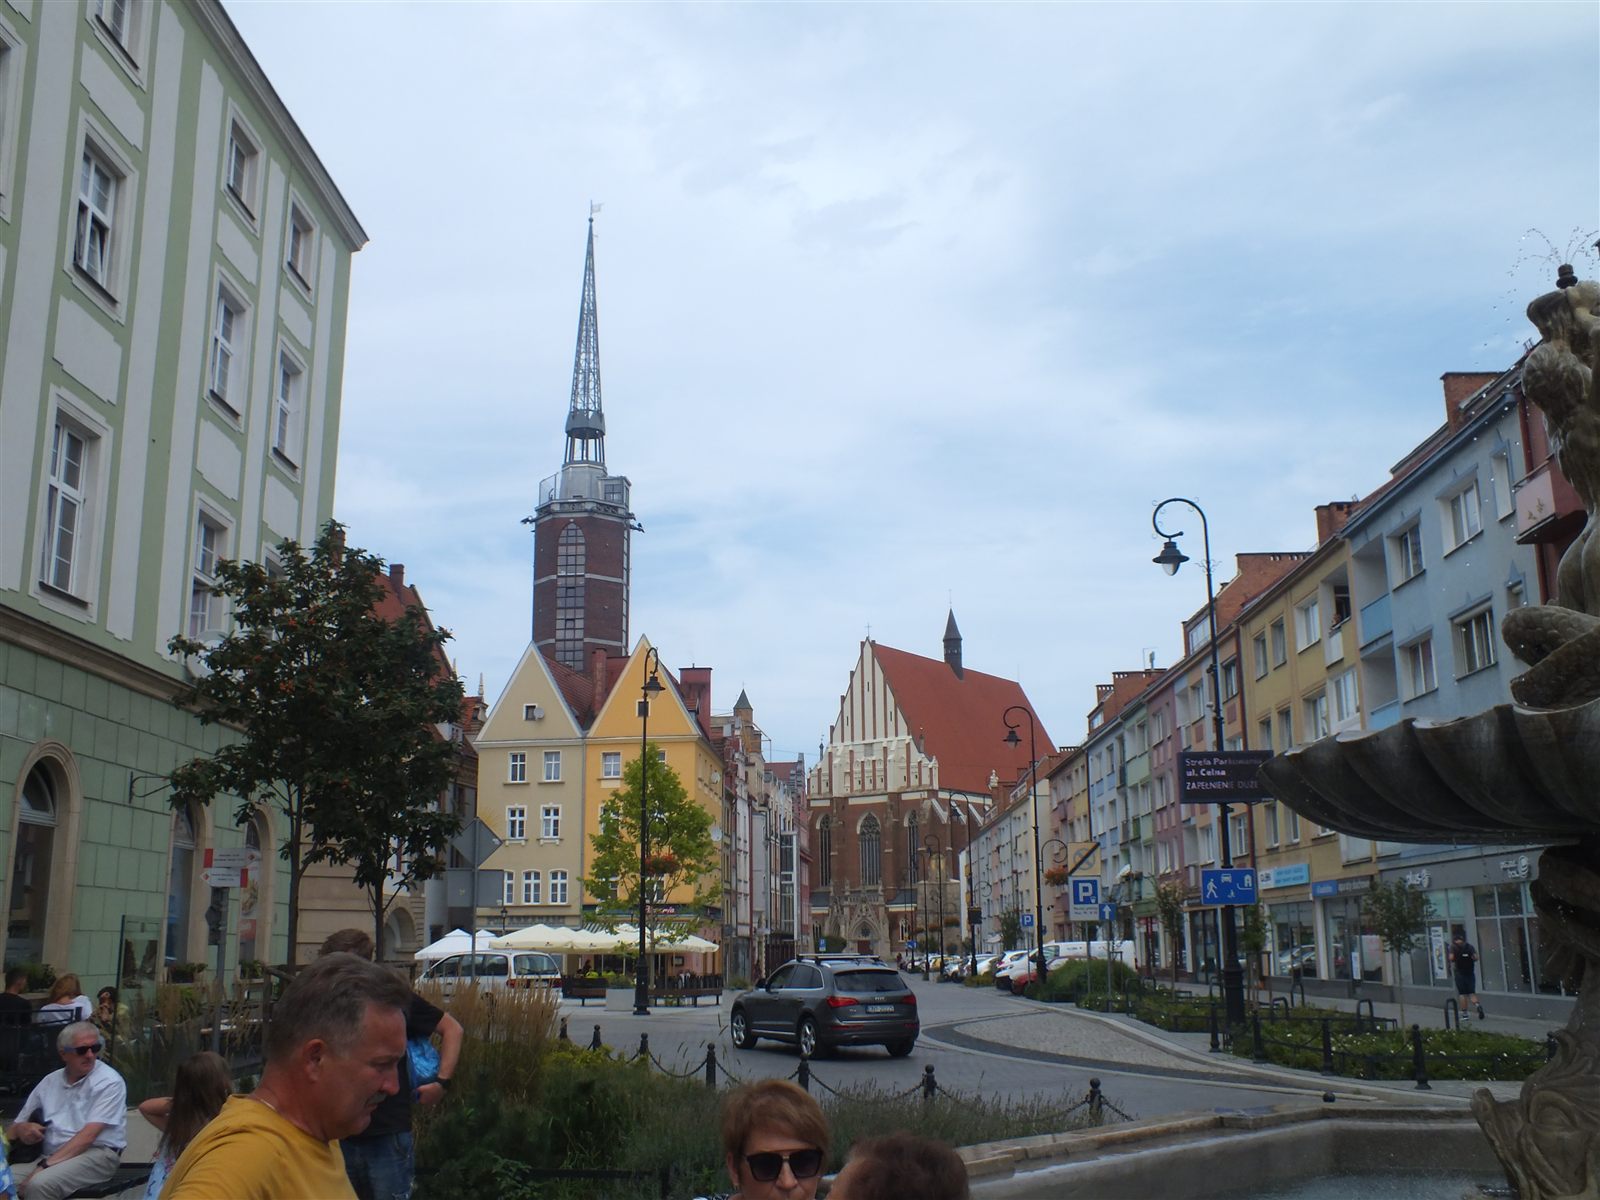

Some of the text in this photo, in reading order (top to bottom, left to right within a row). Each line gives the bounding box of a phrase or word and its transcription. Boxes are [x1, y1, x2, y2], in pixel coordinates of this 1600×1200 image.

[1185, 758, 1212, 767] Strefa
[1186, 768, 1226, 777] ul. Celna
[1078, 882, 1093, 902] P
